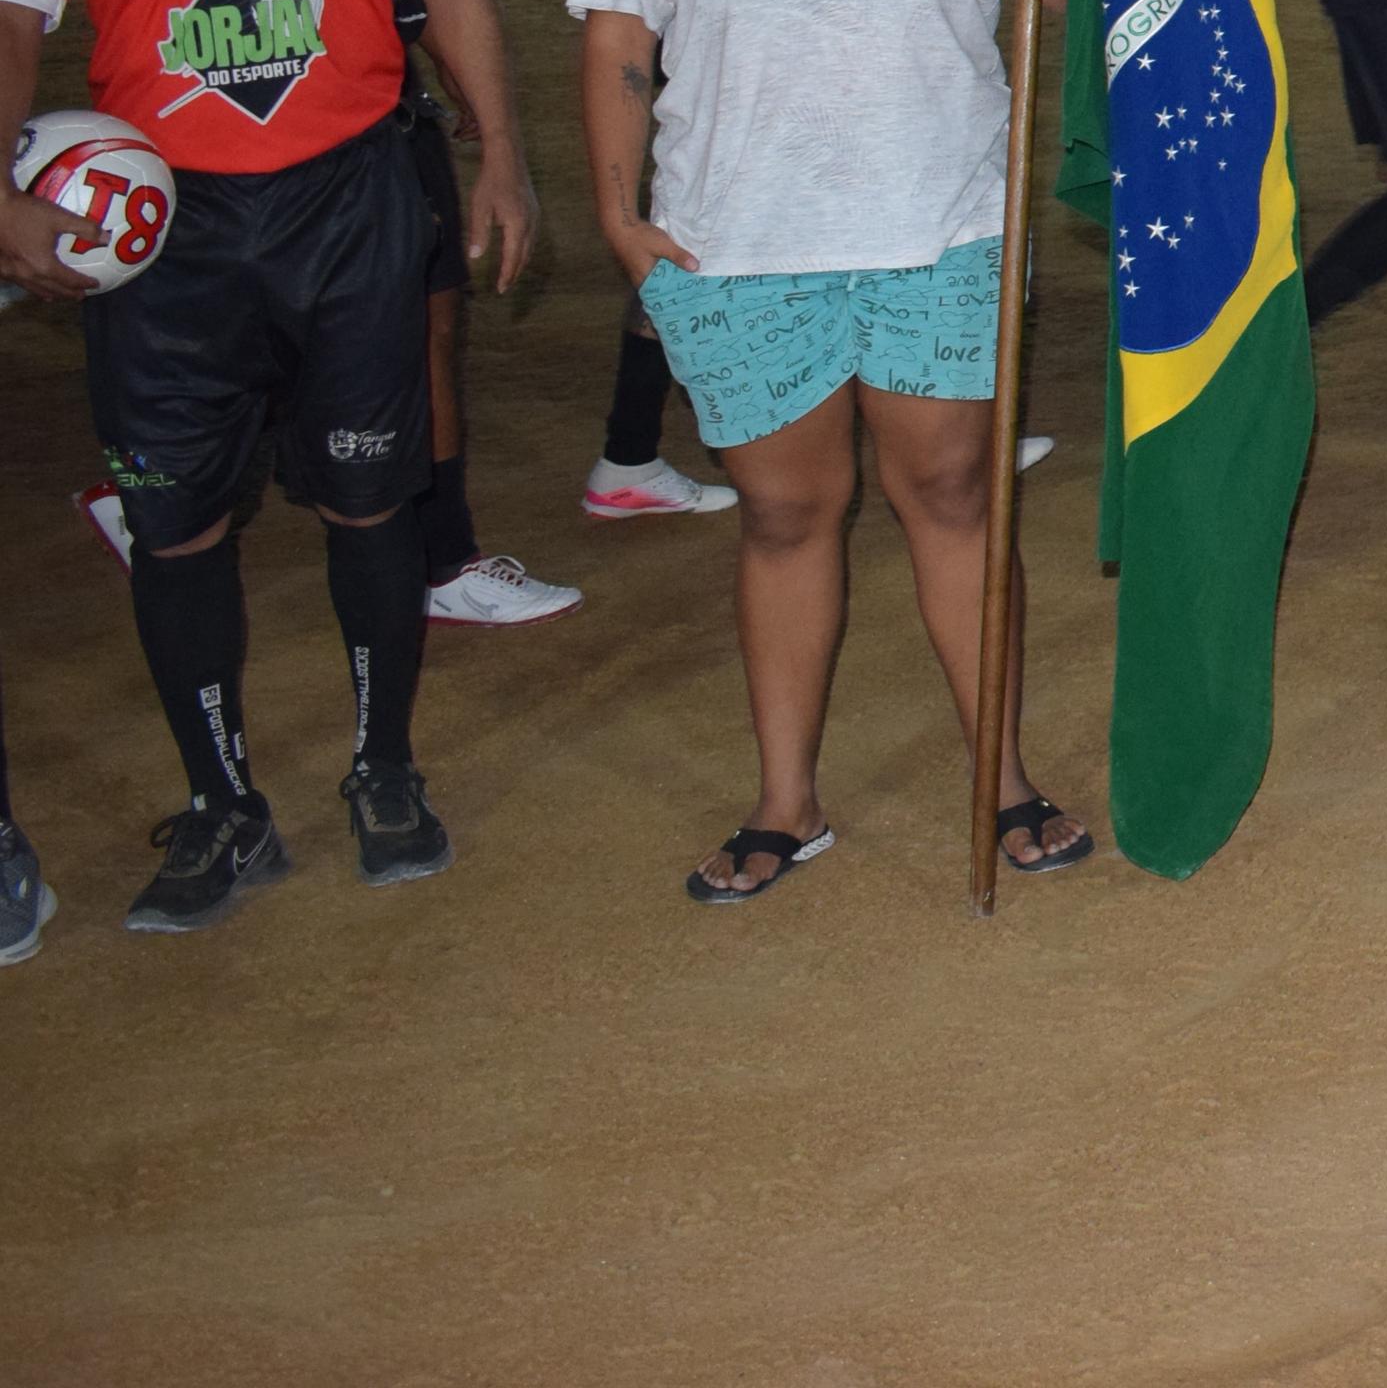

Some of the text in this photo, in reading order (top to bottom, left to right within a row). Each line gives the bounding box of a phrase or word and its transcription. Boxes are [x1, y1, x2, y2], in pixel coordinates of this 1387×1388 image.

[207, 59, 302, 87] DO ESPORTE
[676, 276, 708, 292] LOVE
[946, 274, 981, 289] love
[938, 289, 1001, 308] LOVE
[688, 309, 732, 335] love
[744, 308, 782, 332] love
[884, 322, 922, 340] love
[933, 335, 982, 363] love
[720, 381, 753, 400] love
[765, 364, 815, 401] love
[887, 368, 937, 397] love
[203, 688, 219, 704] FS
[207, 706, 248, 797] FOOTBALLSOCKS
